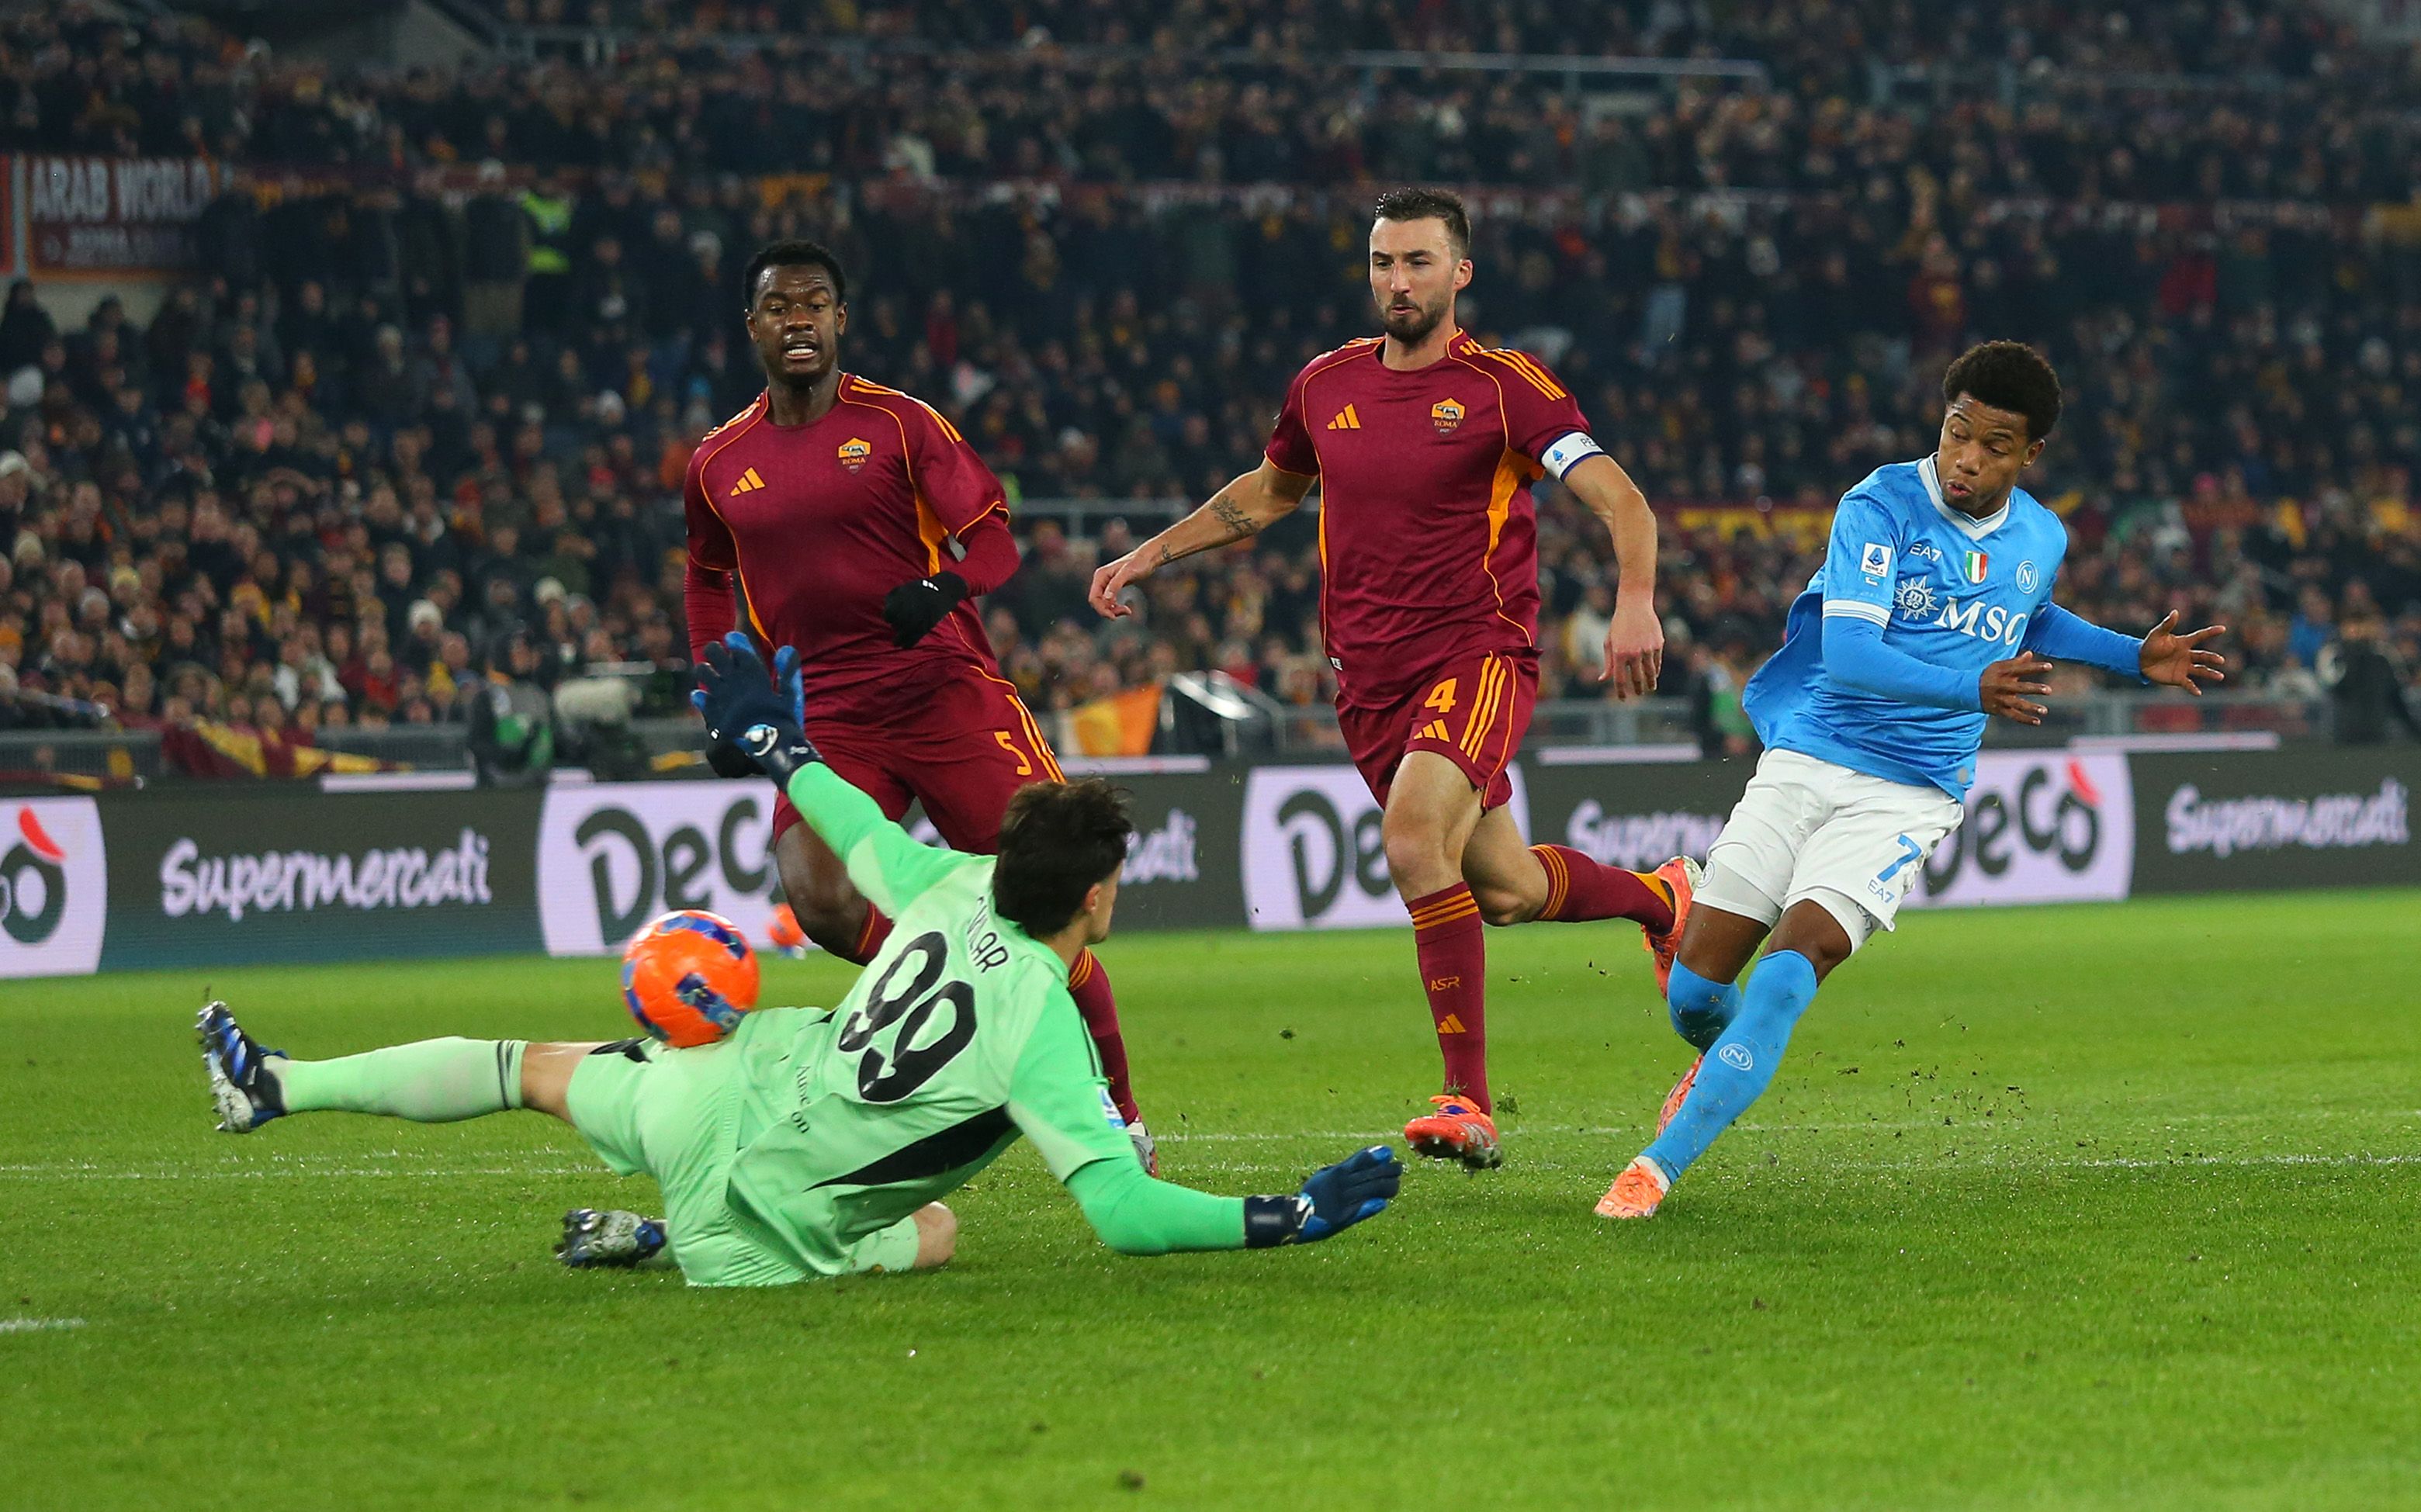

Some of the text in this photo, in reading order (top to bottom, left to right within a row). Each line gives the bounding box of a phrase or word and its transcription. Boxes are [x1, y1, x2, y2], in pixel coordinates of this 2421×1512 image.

[31, 157, 212, 223] ARAB WORLD
[1433, 420, 1457, 428] ROMA
[1910, 543, 1942, 562] EA7
[1933, 596, 2028, 646] MSC
[1425, 677, 1457, 713] 4
[994, 731, 1033, 776] 5
[2166, 777, 2411, 859] Supermercati
[160, 826, 491, 922] Supermercati
[576, 798, 787, 946] Dec
[1877, 833, 1922, 882] 7
[1867, 879, 1895, 904] EA7
[1431, 976, 1460, 991] ASR
[838, 931, 978, 1105] 99
